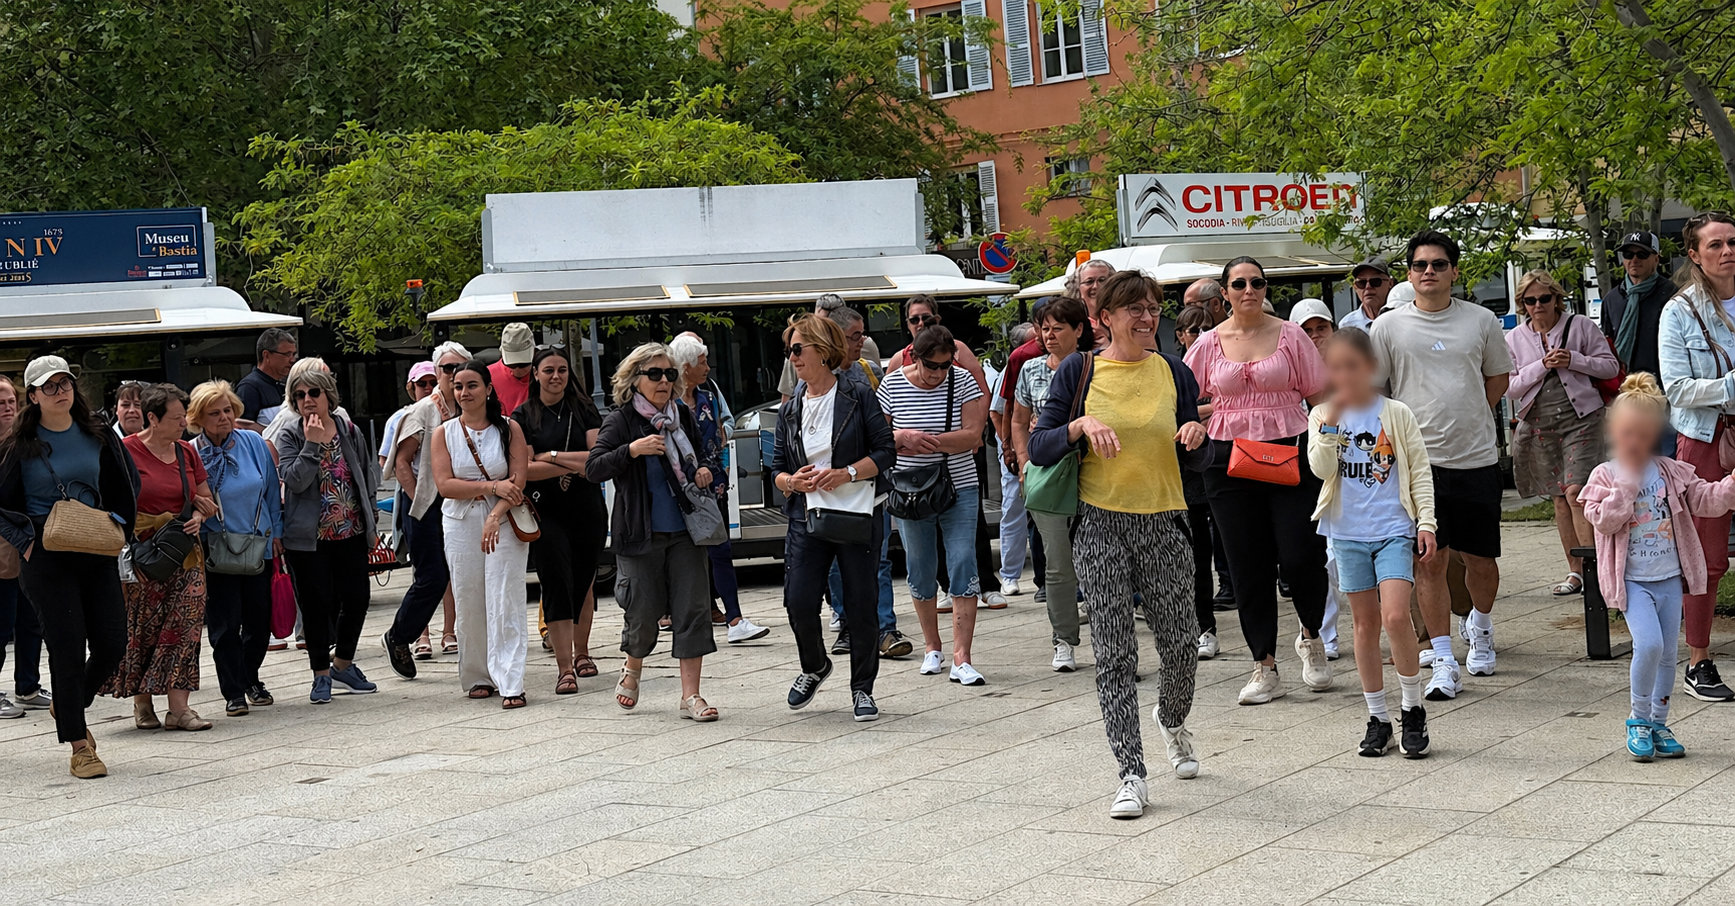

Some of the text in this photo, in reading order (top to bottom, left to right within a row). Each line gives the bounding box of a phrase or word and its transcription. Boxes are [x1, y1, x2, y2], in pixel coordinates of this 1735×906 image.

[1187, 218, 1226, 228] SOCODIA
[145, 233, 189, 245] Museu
[33, 236, 63, 257] IV
[159, 244, 198, 257] Bastia
